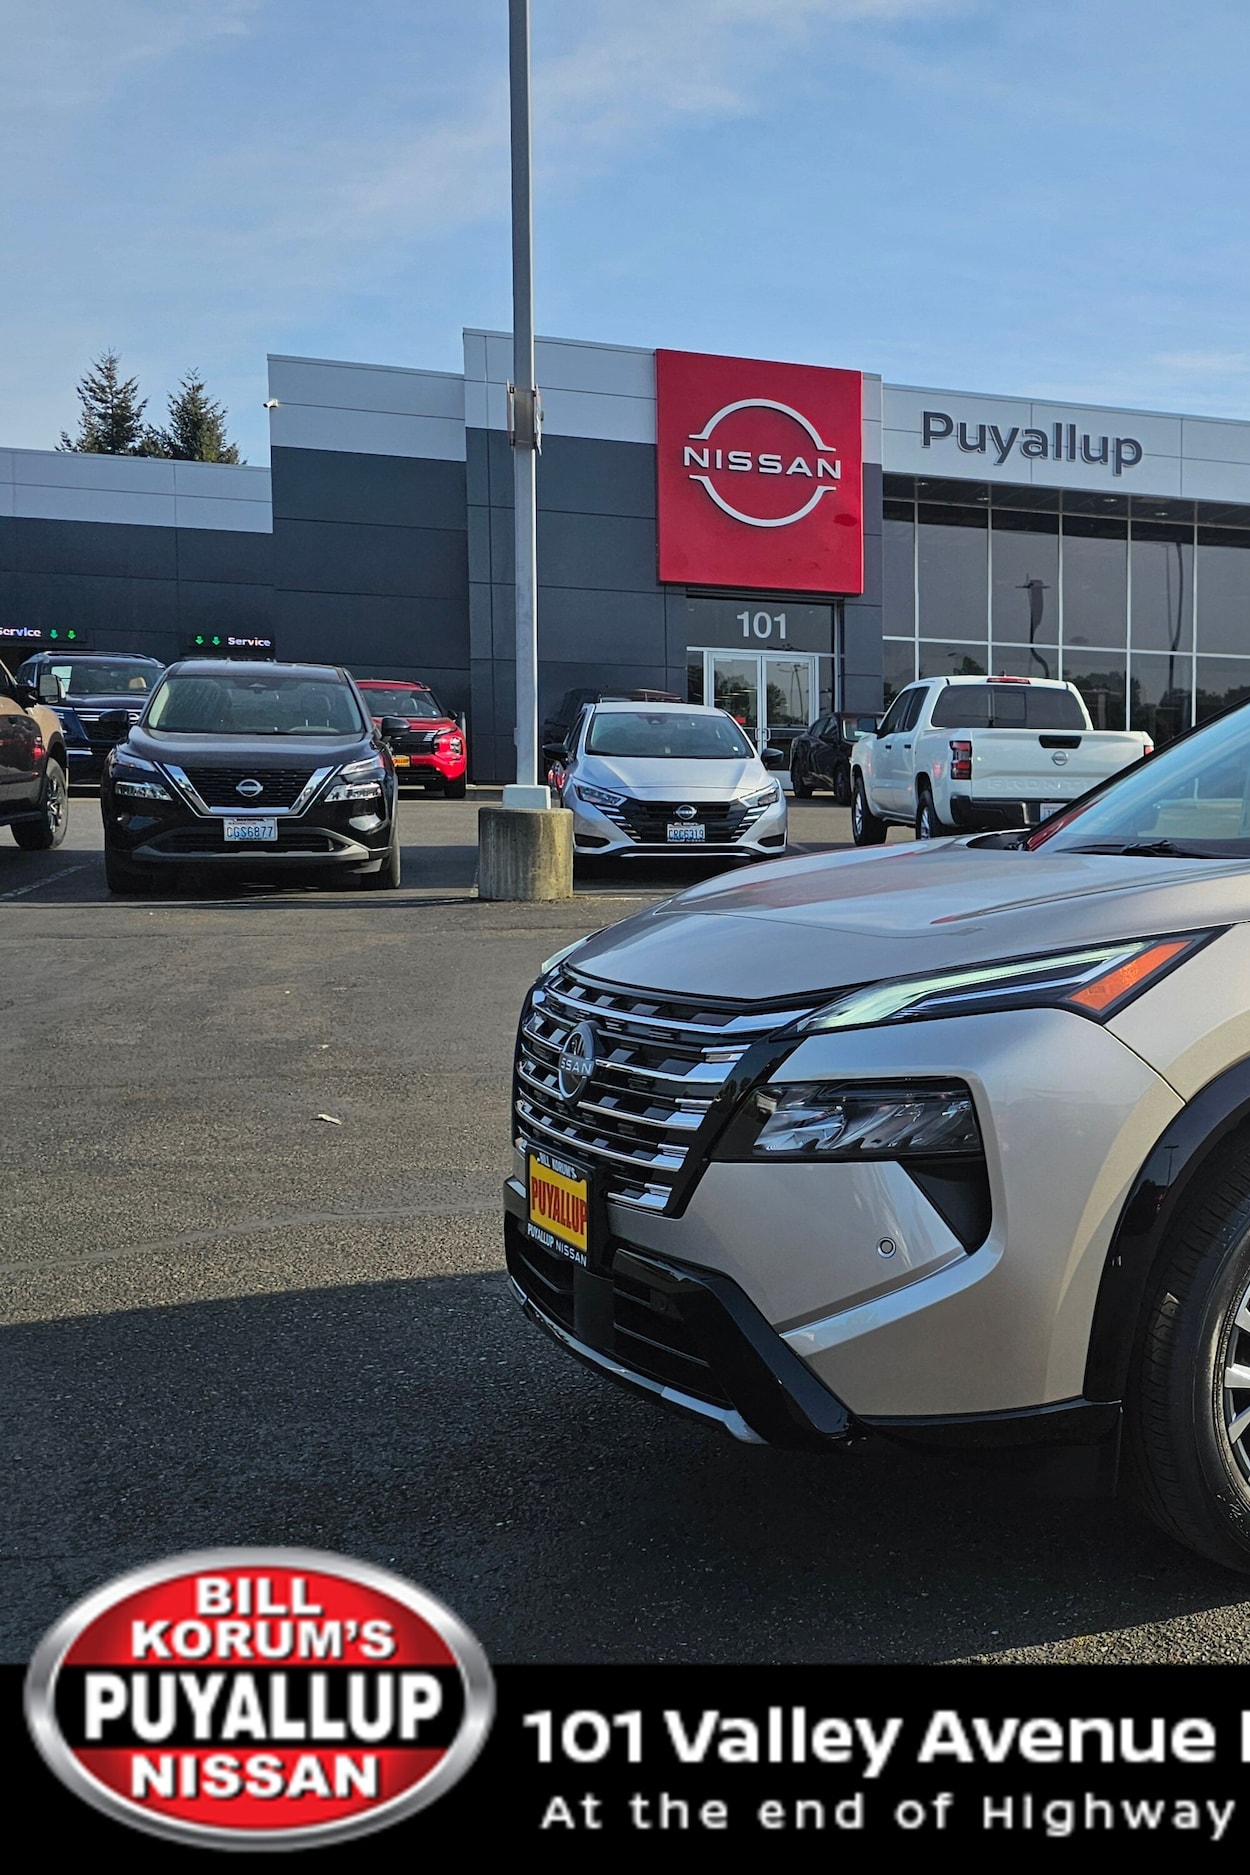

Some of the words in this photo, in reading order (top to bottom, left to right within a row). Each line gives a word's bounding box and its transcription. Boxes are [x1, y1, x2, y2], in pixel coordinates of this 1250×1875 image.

[921, 410, 1144, 477] Puyallup
[683, 446, 841, 480] NISSAN
[227, 636, 272, 647] Service
[736, 611, 786, 639] 101
[560, 1057, 592, 1075] SSAN
[531, 1175, 588, 1236] PUYALLUP
[527, 1222, 555, 1249] PUYALLUP
[555, 1240, 587, 1267] NISSAN
